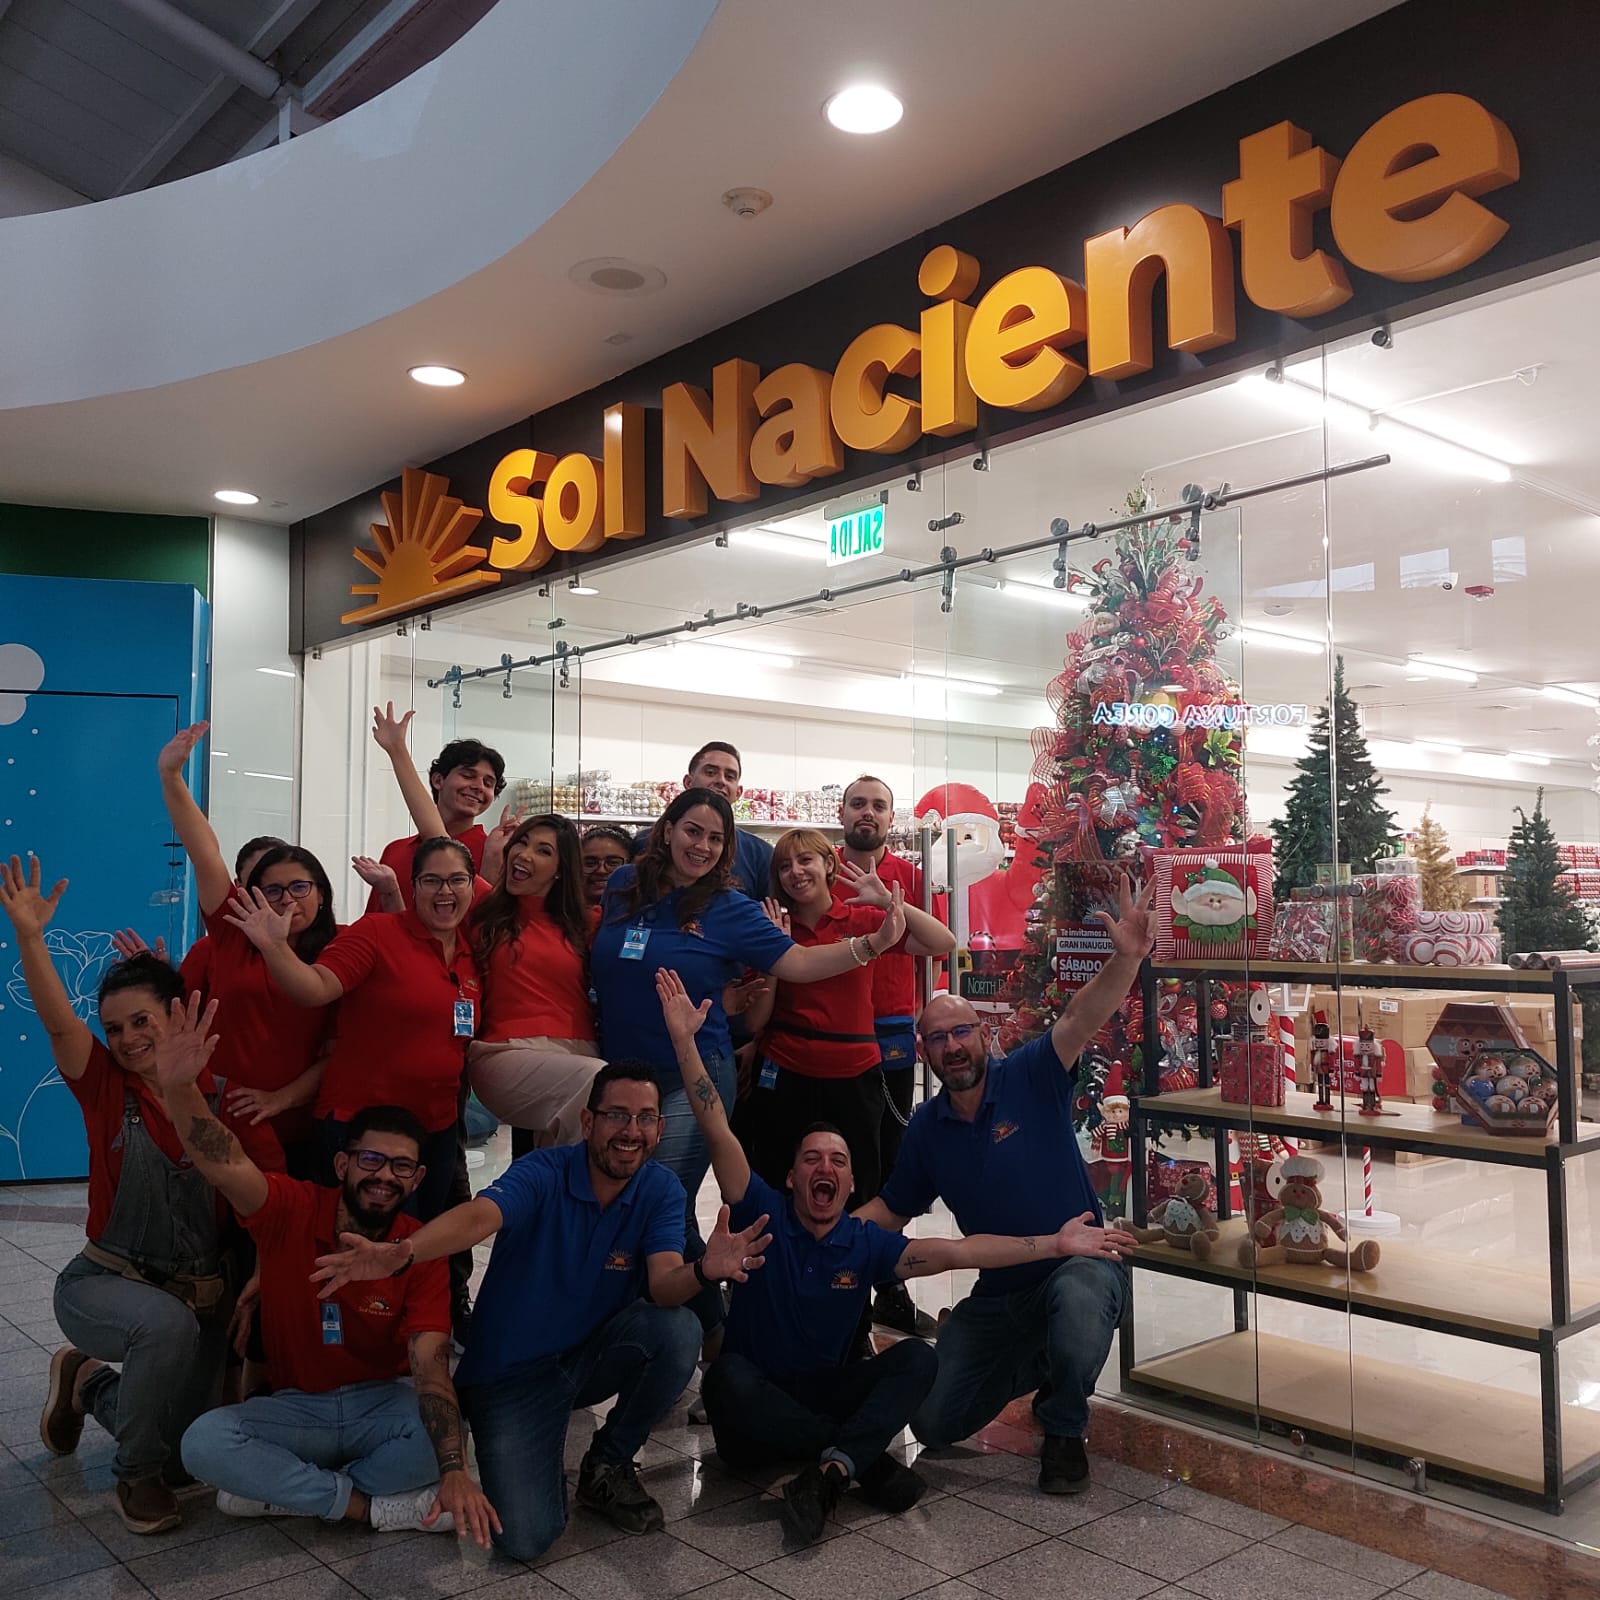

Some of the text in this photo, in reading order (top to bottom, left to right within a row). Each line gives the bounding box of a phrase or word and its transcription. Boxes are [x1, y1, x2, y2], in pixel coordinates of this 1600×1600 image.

[488, 92, 1520, 571] Sol Naciente
[1060, 928, 1068, 936] Te
[1069, 928, 1101, 937] invitamos
[1059, 940, 1114, 950] GRAN INAUGUR
[1060, 955, 1102, 971] SÁBADO
[1060, 971, 1097, 982] DE SETIE
